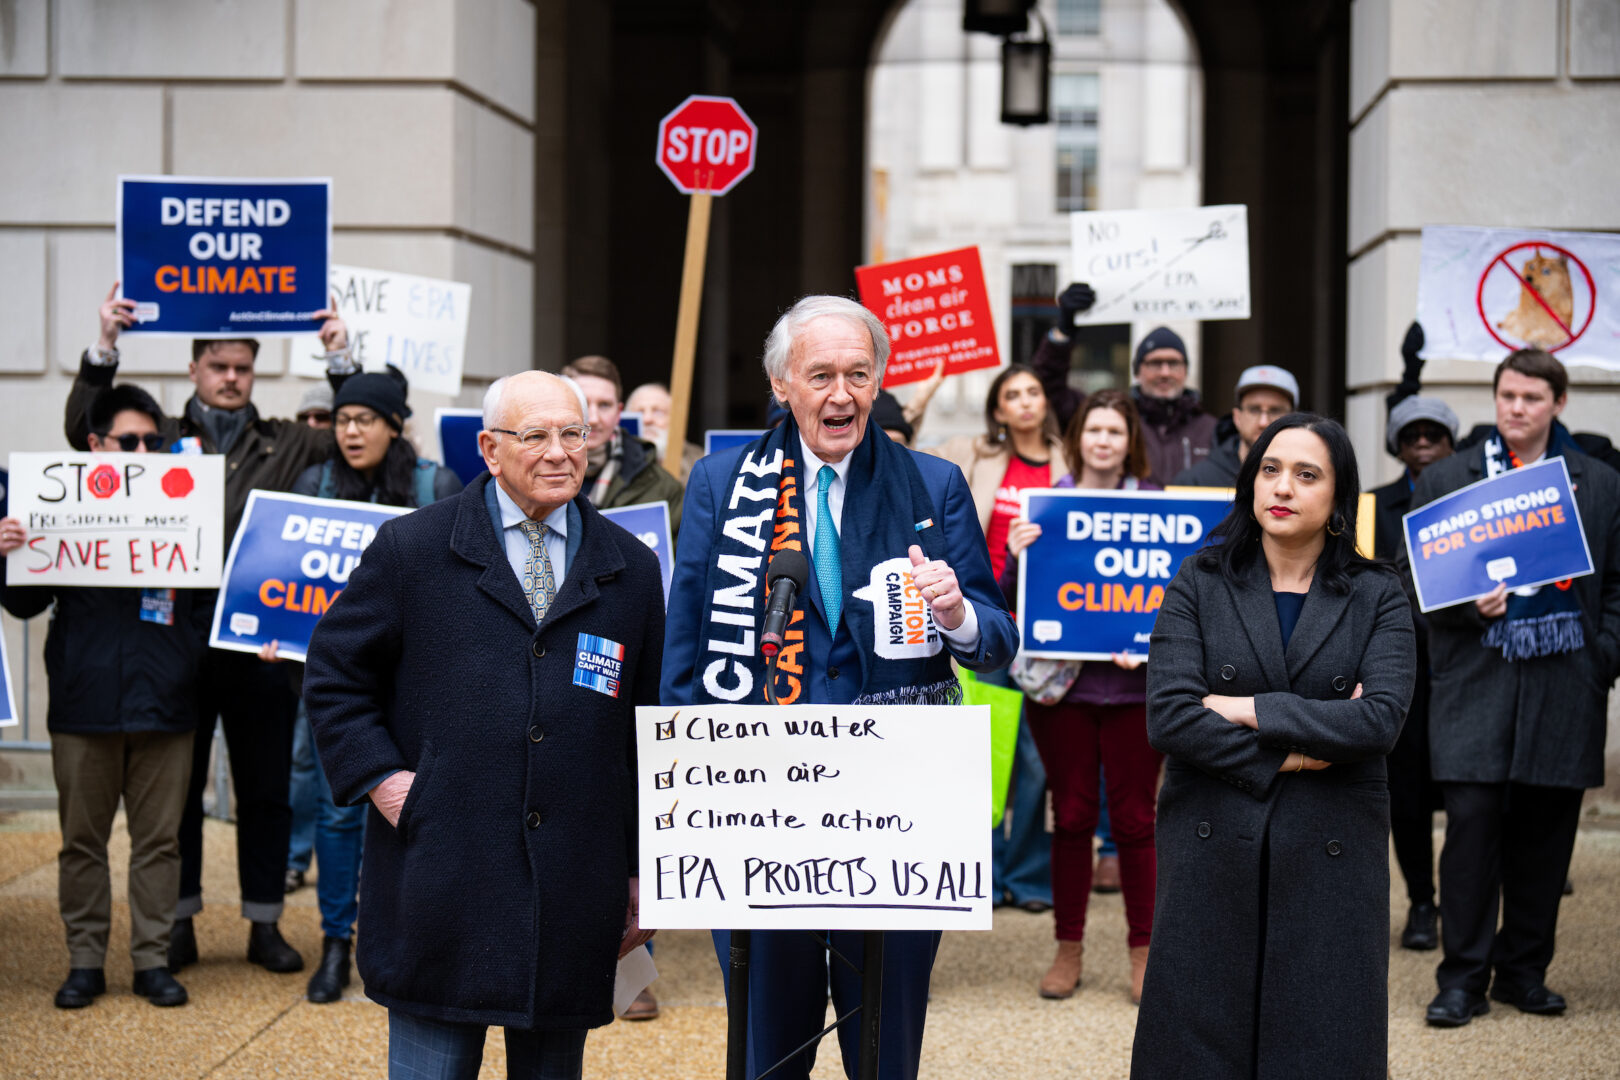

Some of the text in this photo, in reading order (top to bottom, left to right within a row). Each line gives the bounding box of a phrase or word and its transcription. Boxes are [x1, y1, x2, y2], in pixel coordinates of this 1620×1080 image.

[667, 125, 749, 166] STOP
[161, 197, 291, 227] DEFEND
[189, 231, 262, 261] OUR
[1088, 221, 1120, 244] NO
[1088, 237, 1158, 276] CUTS!
[155, 265, 297, 293] CLIMATE
[881, 264, 964, 296] MOMS
[408, 283, 456, 320] EPA
[885, 286, 968, 319] clean air
[889, 309, 975, 341] FORCE
[386, 334, 455, 376] LIVES
[38, 462, 145, 502] STOP
[30, 511, 189, 528] PRESIDENT MUSK
[1066, 511, 1203, 544] DEFEND
[1418, 486, 1561, 543] STAND STRONG
[1422, 505, 1566, 560] FOR CLIMATE
[27, 527, 201, 574] SAVE EPA!
[300, 549, 362, 583] OU
[1094, 547, 1172, 578] OUR
[703, 449, 784, 701] CLIMATE
[886, 572, 904, 645] CAMPAIGN
[903, 571, 925, 644] ACTION
[1057, 582, 1166, 613] CLIMA
[578, 652, 621, 671] CLIMATE
[578, 661, 620, 679] CAN'T WAIT
[686, 716, 769, 741] Clean
[686, 765, 767, 785] Clean
[687, 809, 913, 832] Climate action
[656, 855, 987, 901] EPA PROTECTS US ALL
